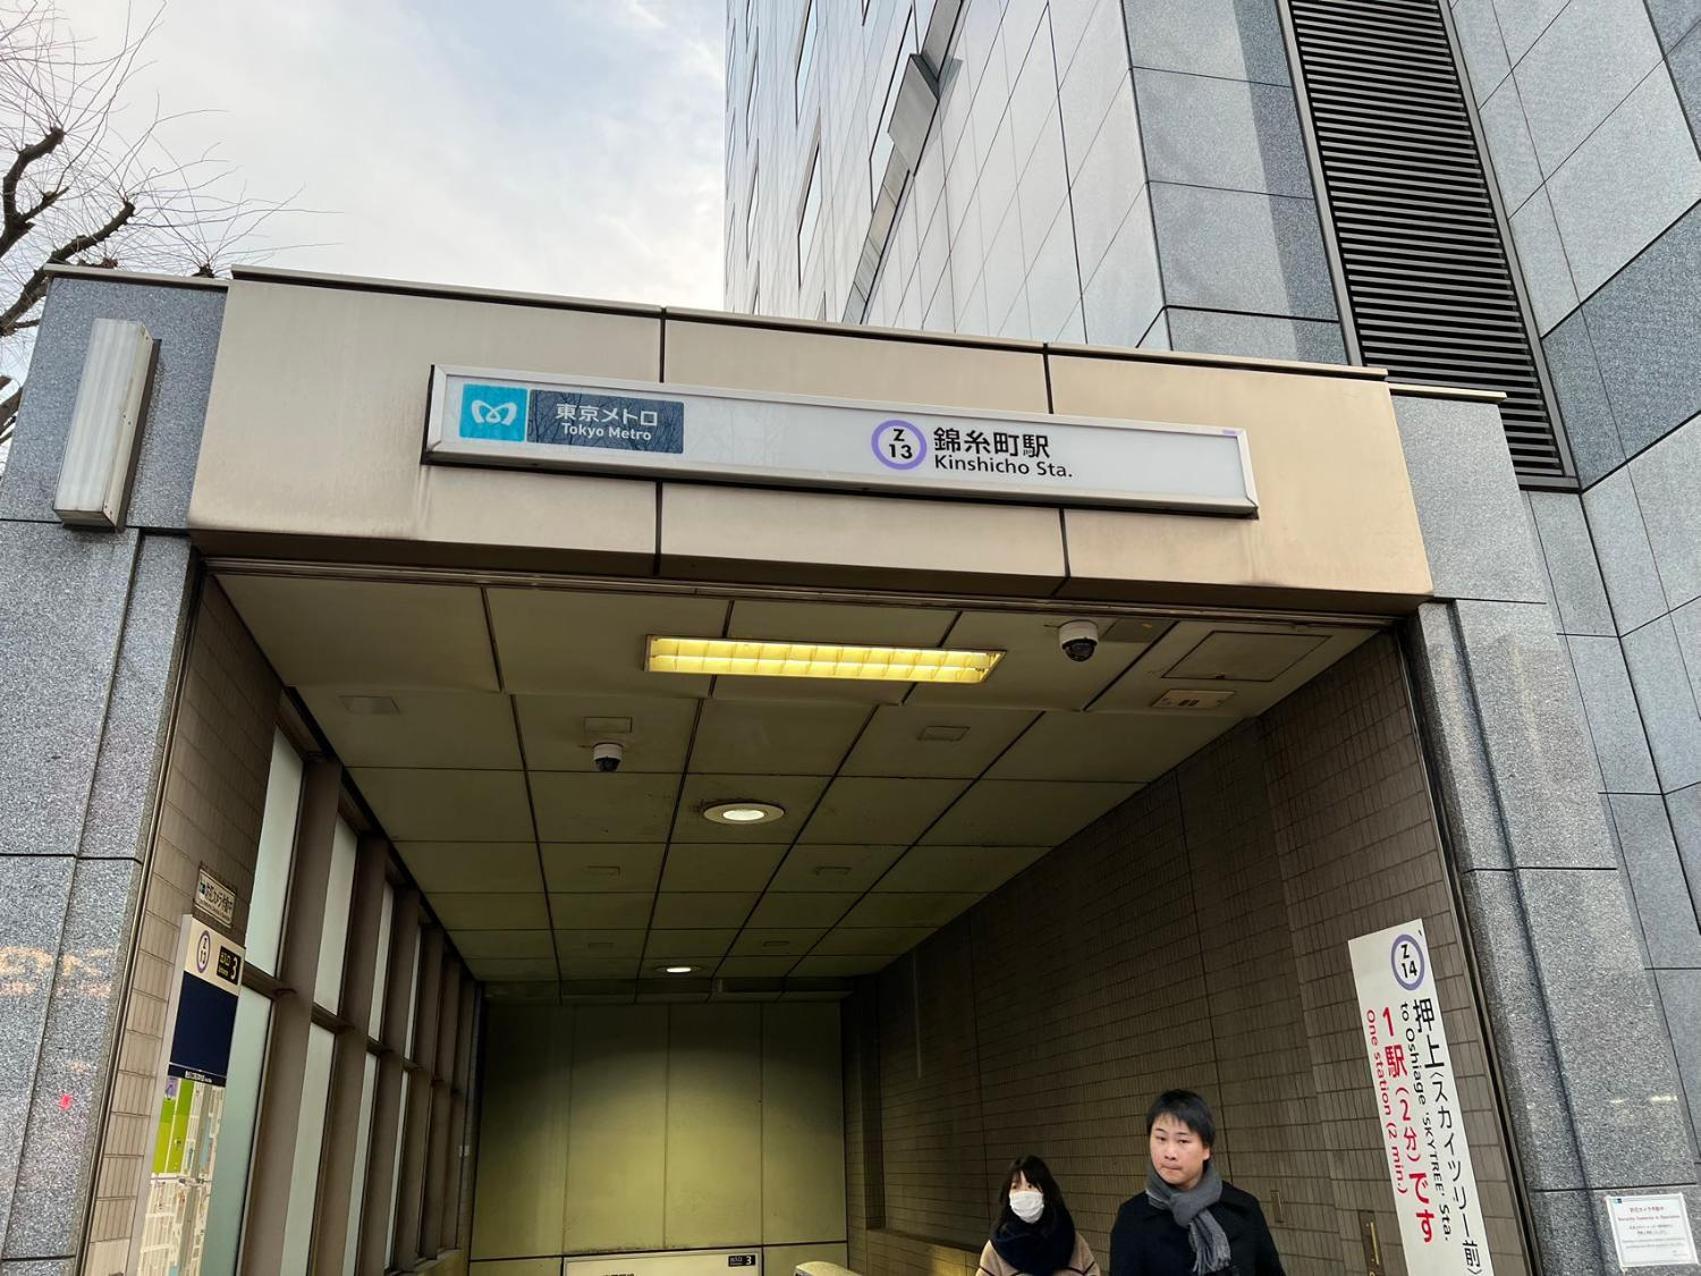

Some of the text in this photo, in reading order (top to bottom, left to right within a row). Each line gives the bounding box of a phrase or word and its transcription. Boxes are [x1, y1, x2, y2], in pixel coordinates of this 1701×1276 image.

[555, 402, 658, 427] 東京メトロ
[561, 422, 652, 441] Tokyo Metro
[893, 428, 905, 442] Z
[888, 443, 913, 460] 13
[933, 427, 1050, 459] 錦糸町駅
[934, 454, 1073, 478] Kinshicho Sta.
[1400, 943, 1410, 960] Z
[230, 956, 238, 980] 3
[1401, 960, 1418, 979] 14
[1366, 1009, 1408, 1194] One station (2 min.)
[1400, 1002, 1410, 1022] to
[1405, 1027, 1426, 1106] Oshiage
[1438, 1204, 1452, 1242] Sta.
[745, 1255, 752, 1265] 3
